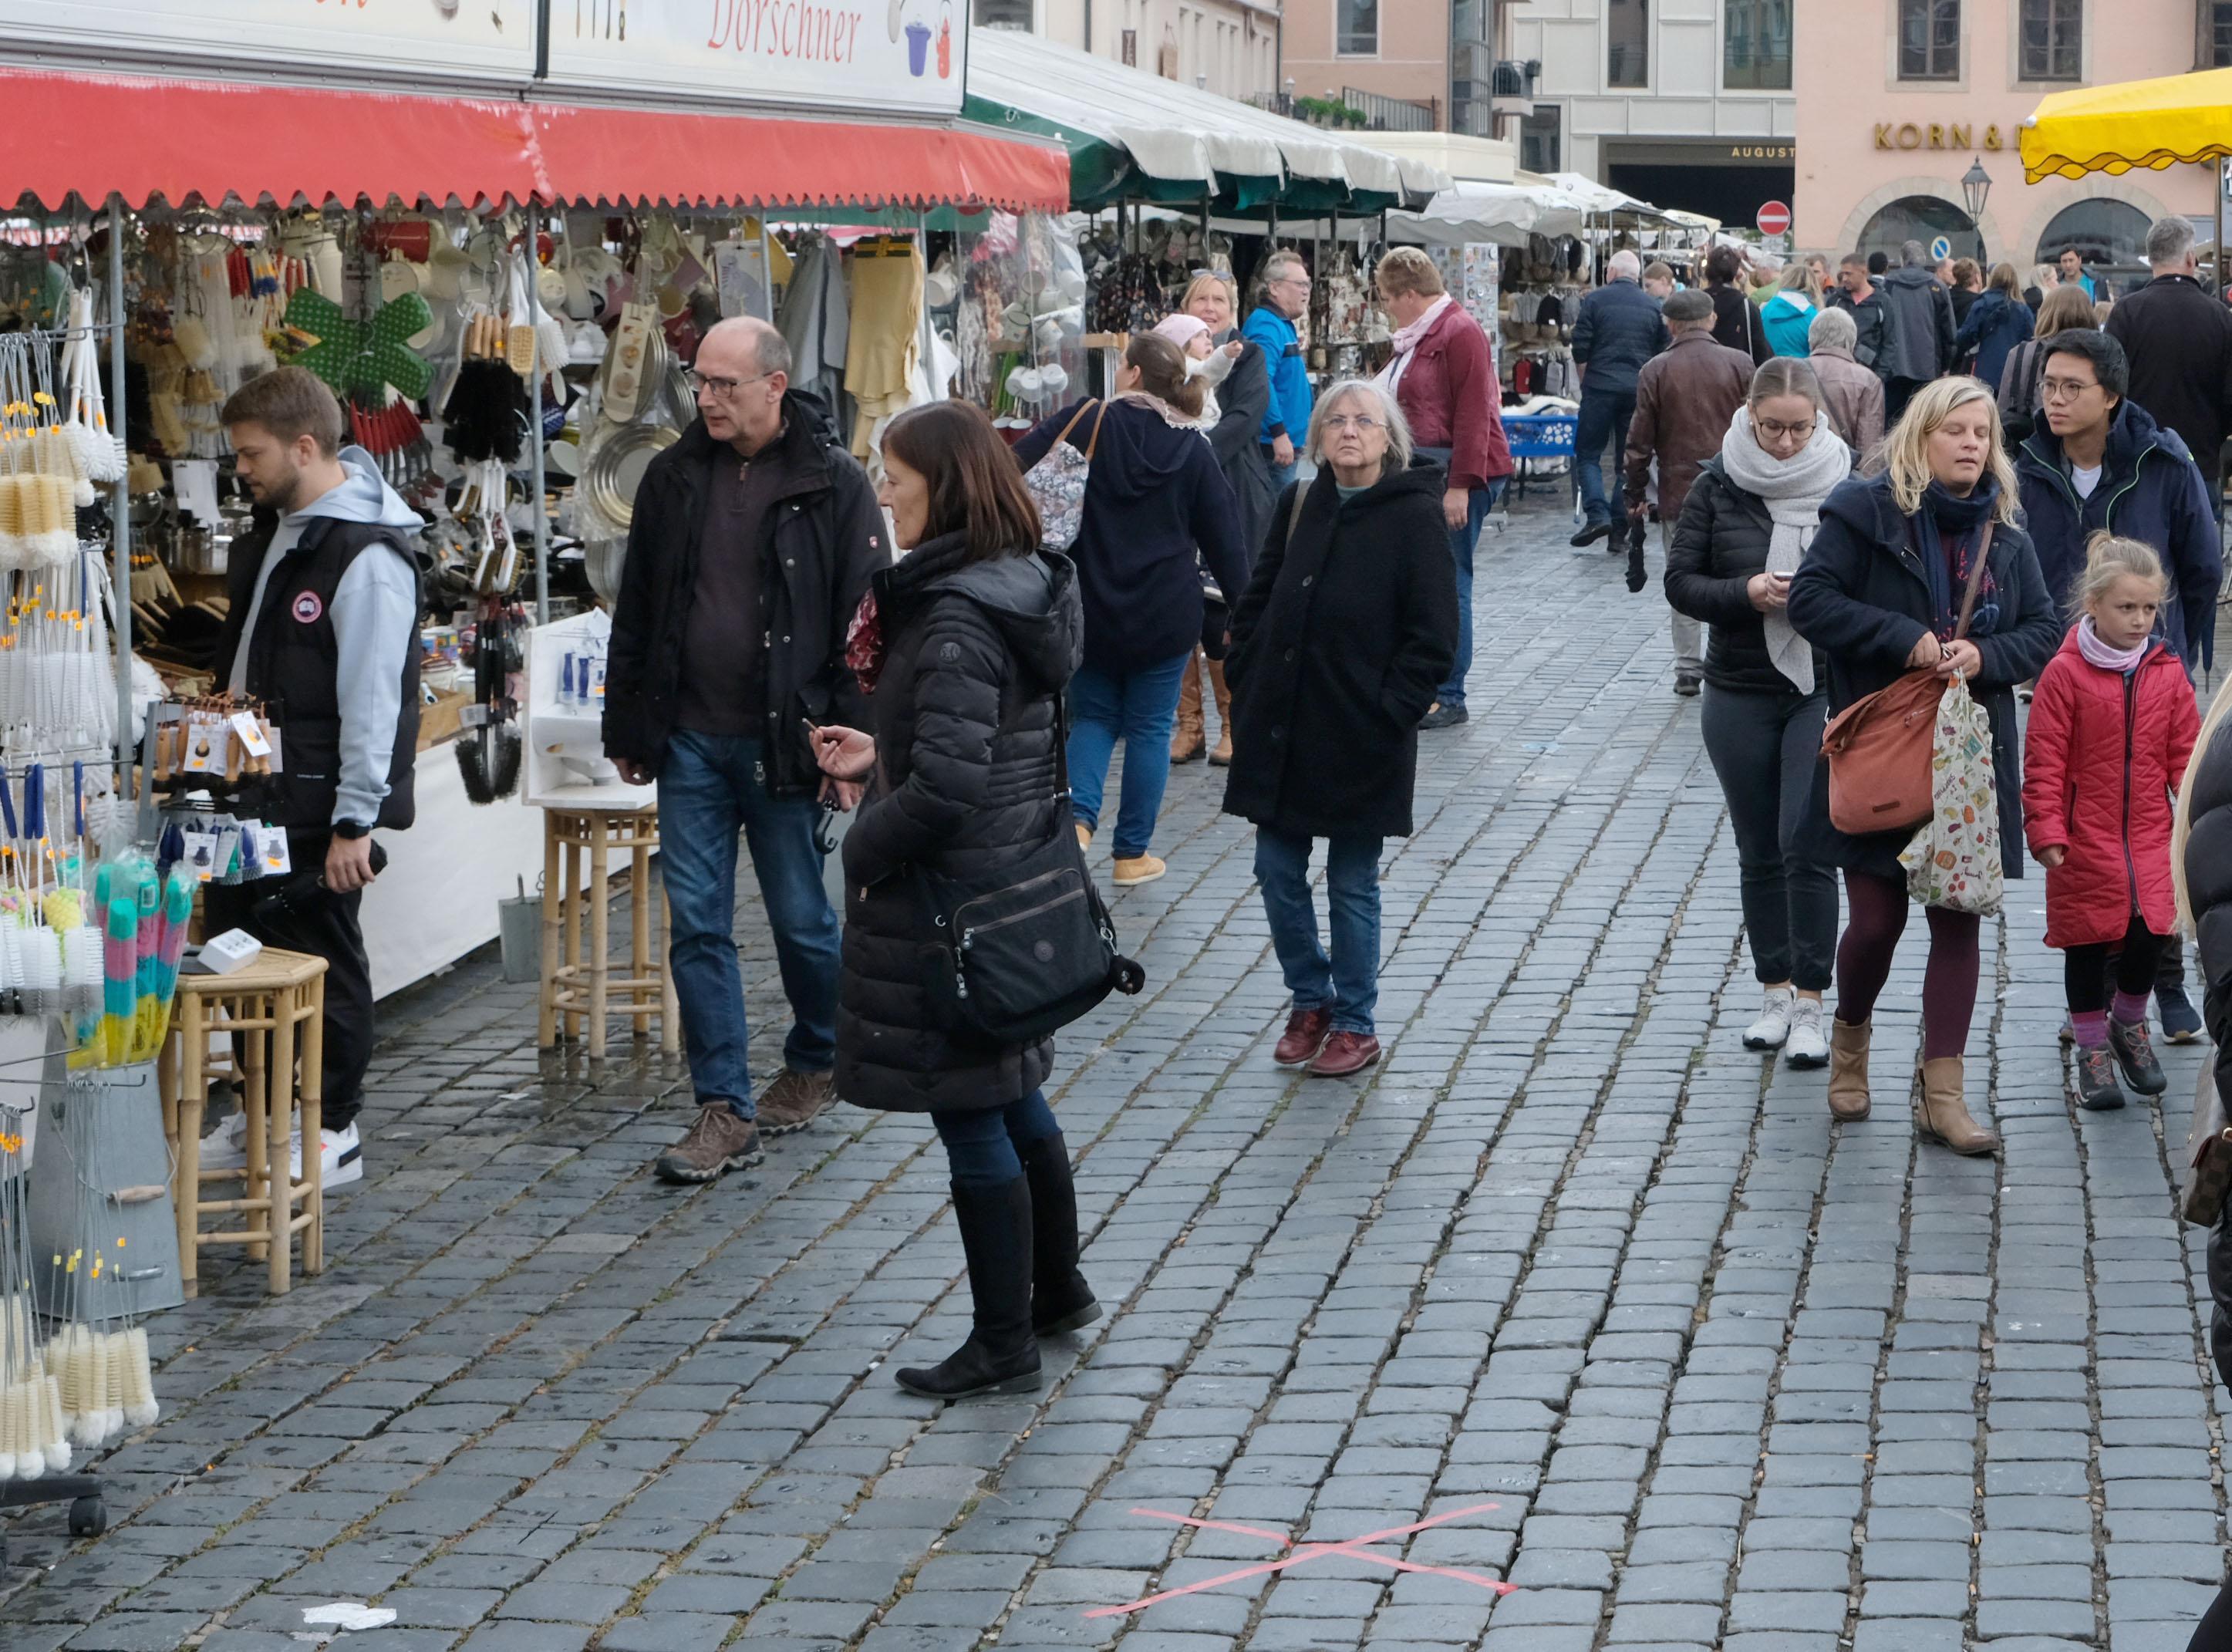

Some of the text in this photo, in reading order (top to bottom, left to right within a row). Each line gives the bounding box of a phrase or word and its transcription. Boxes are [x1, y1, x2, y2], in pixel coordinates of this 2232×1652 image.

[1874, 123, 1972, 150] KORN
[1984, 123, 2003, 150] &
[1731, 147, 1795, 158] AUGUST
